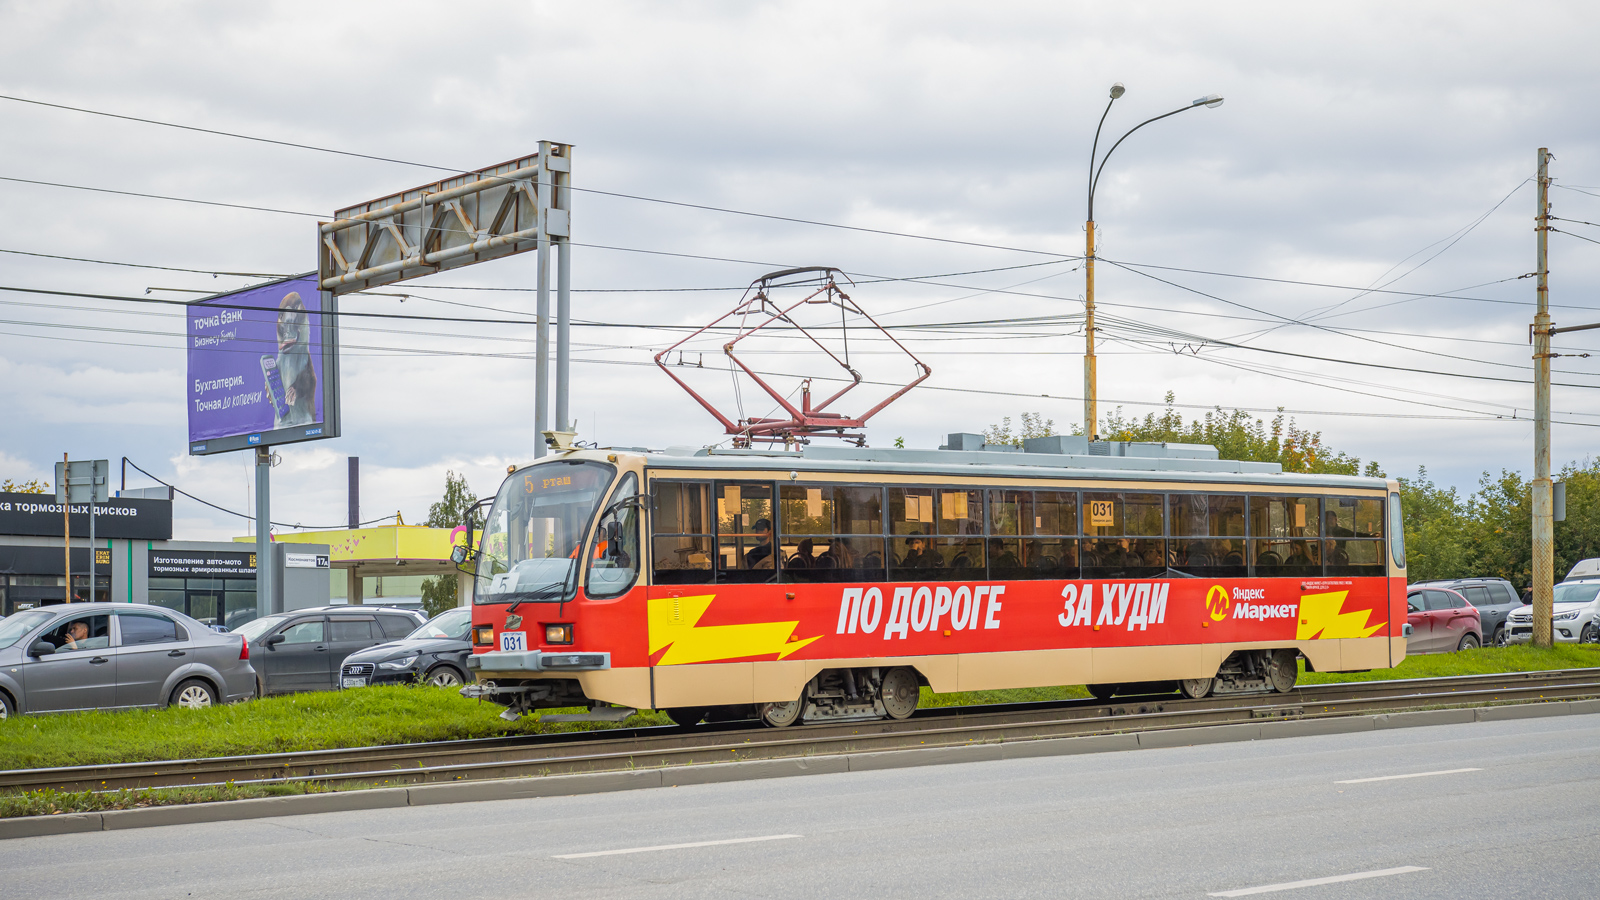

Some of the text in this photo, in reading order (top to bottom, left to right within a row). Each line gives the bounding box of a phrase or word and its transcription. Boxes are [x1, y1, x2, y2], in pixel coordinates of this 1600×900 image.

[194, 309, 243, 330] точка банк
[194, 334, 220, 348] Бизнесу
[194, 375, 245, 396] Бухгалтерия.
[194, 399, 222, 413] Точная
[221, 396, 232, 410] до
[524, 475, 534, 494] 5
[15, 502, 89, 515] тормозных
[93, 506, 137, 516] дисков
[1093, 503, 1112, 516] 031
[153, 556, 204, 565] Изготовление
[206, 558, 242, 566] авто-мото
[499, 576, 510, 594] 5
[1232, 586, 1265, 601] Яндекс
[836, 585, 1006, 640] ПО ДОРОГЕ
[1058, 582, 1170, 631] ЗА ХУДИ
[1232, 602, 1298, 622] Маркет
[503, 636, 522, 651] 031
